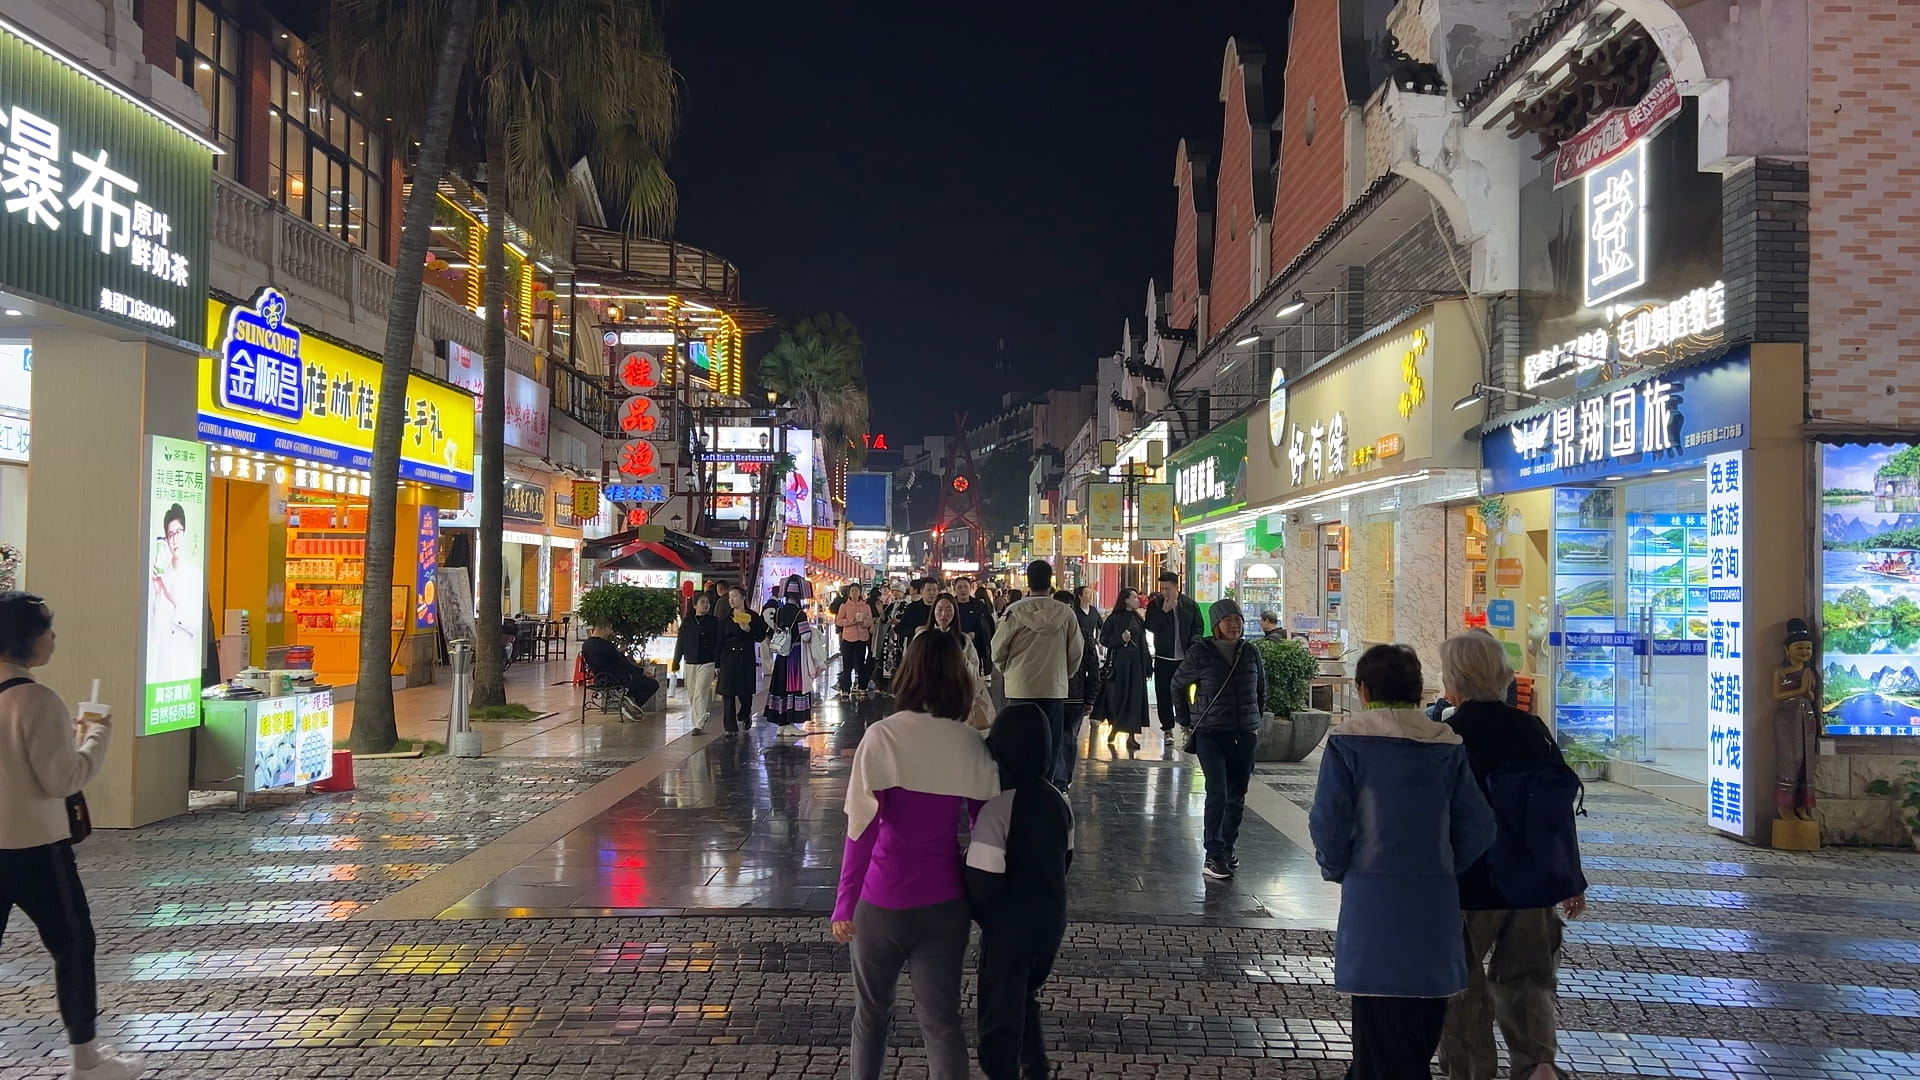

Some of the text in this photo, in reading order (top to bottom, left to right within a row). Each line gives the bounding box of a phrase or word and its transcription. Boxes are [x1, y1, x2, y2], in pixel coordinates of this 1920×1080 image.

[131, 200, 172, 246] 原叶
[131, 235, 189, 287] 鲜奶茶
[234, 321, 297, 358] SUNCOME
[1617, 280, 1725, 358] 专业舞蹈教室
[229, 349, 299, 411] 金顺昌
[198, 423, 256, 443] GUIHUA BANSHOULI
[274, 437, 292, 450] GUILIN
[1553, 380, 1672, 469] 鼎翔国旅
[1288, 411, 1344, 487] 好有缘
[156, 469, 203, 490] 我是毛不易
[1710, 459, 1739, 495] 免费
[1710, 502, 1739, 537] 旅游
[1710, 546, 1739, 580] 咨询
[1710, 618, 1741, 660] 漓江
[150, 702, 196, 726] 自然轻负担
[1710, 671, 1741, 715] 游船
[1710, 724, 1741, 770] 竹筏
[1710, 777, 1741, 824] 售票
